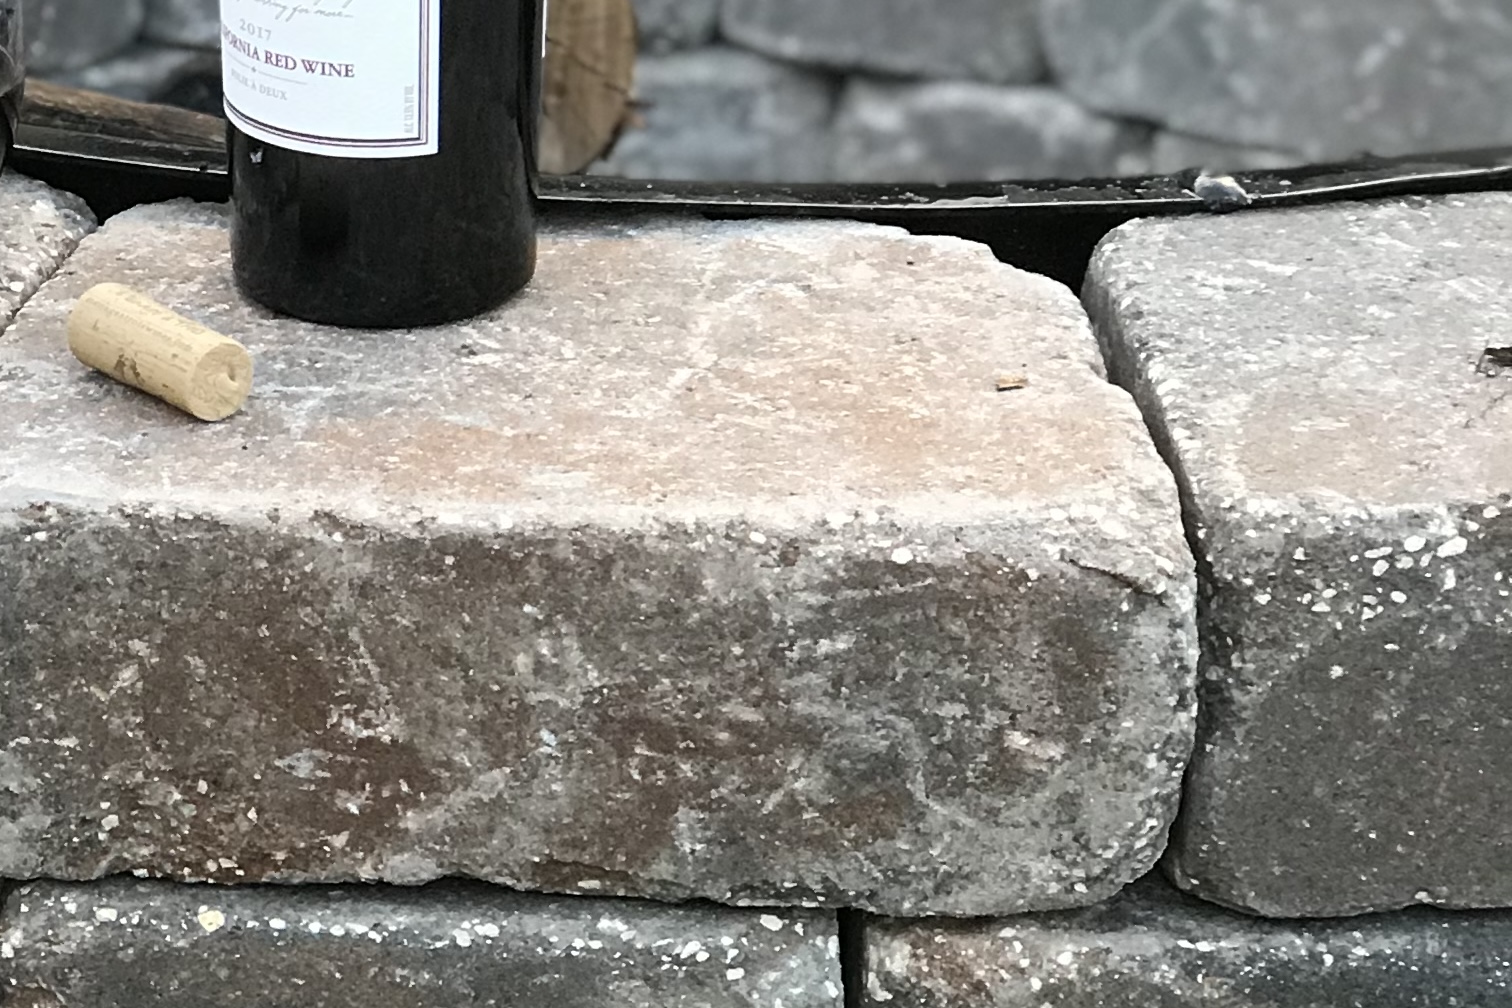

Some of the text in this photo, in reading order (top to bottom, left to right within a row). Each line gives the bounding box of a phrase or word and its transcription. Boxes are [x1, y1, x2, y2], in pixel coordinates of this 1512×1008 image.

[239, 18, 273, 42] 2017
[264, 49, 297, 71] RED
[301, 58, 356, 78] WINE
